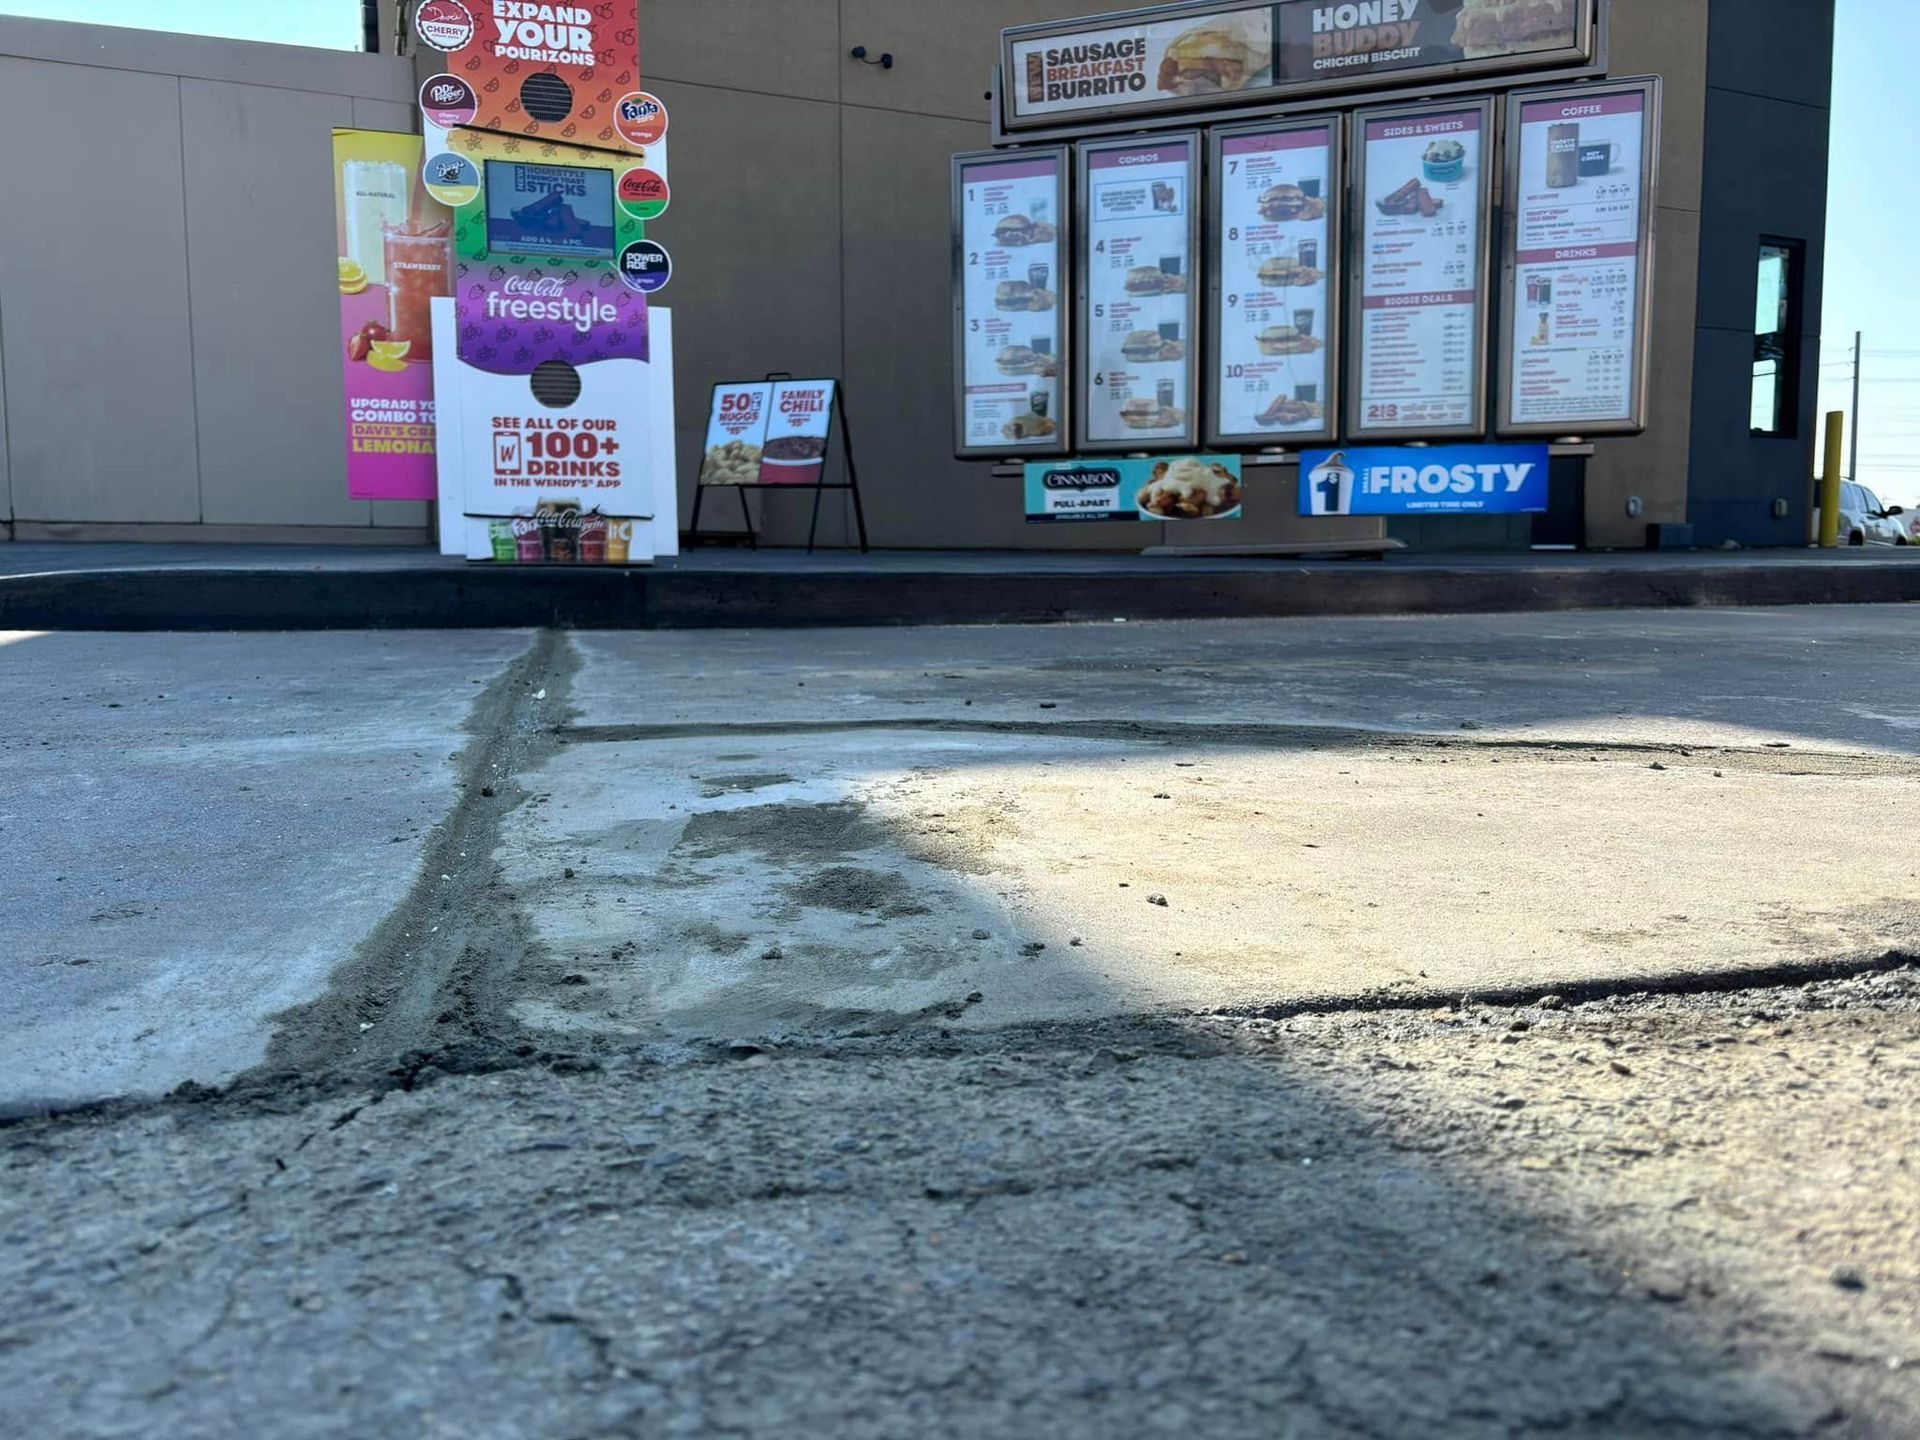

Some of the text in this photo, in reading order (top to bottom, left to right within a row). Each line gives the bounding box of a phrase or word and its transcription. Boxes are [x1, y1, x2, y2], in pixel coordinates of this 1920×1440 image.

[493, 0, 592, 25] EXPAND
[1312, 0, 1417, 32] HONEY
[426, 25, 465, 36] CHERRY
[492, 18, 593, 52] YOUR
[1312, 21, 1420, 59] BUDDY
[495, 45, 595, 66] POURIZONS
[1046, 38, 1146, 68] SAUSAGE
[1313, 47, 1421, 70] CHICKEN BISCUIT
[1046, 57, 1146, 82] BREAKFAST
[431, 85, 462, 102] Pepper
[1046, 72, 1146, 102] BURRITO
[621, 101, 659, 121] Fanta
[1561, 105, 1602, 117] COFFEE
[1383, 126, 1413, 137] SIDES
[1424, 120, 1464, 133] SWEETS
[1118, 153, 1159, 164] COMBOS
[1228, 161, 1239, 175] 7
[527, 180, 587, 197] STICKS
[623, 178, 662, 193] Coca-Cola
[967, 189, 975, 201] 1
[1228, 227, 1239, 240] 8
[1095, 240, 1104, 253] 4
[1555, 248, 1597, 259] DRINKS
[627, 253, 663, 263] POWER
[969, 252, 978, 265] 2
[392, 261, 441, 271] STRAWBERRY
[503, 275, 568, 297] Coca-Cola
[1227, 294, 1238, 307] 9
[1384, 294, 1454, 306] BIGGIE DEALS
[486, 291, 617, 332] freestyle
[1095, 304, 1104, 317] 5
[970, 319, 980, 332] 3
[1225, 364, 1244, 378] 10
[1094, 373, 1104, 386] 6
[781, 389, 825, 400] FAMILY
[350, 398, 436, 410] UPGRADE YO
[721, 392, 751, 412] 50
[780, 400, 824, 413] CHILI
[351, 409, 417, 423] COMBO
[719, 411, 760, 421] NUGGS
[354, 425, 404, 436] DAVE'S
[492, 416, 617, 431] SEE ALL OF OUR
[352, 439, 434, 454] LEMONA
[526, 431, 620, 459] 100+
[526, 460, 621, 477] DRINKS
[494, 478, 507, 487] IN
[511, 478, 531, 487] THE
[597, 479, 621, 489] APP
[1047, 472, 1116, 487] CINNABON
[1370, 462, 1535, 495] FROSTY
[1053, 499, 1111, 508] PULL-APART
[1406, 501, 1440, 509] LIMITED
